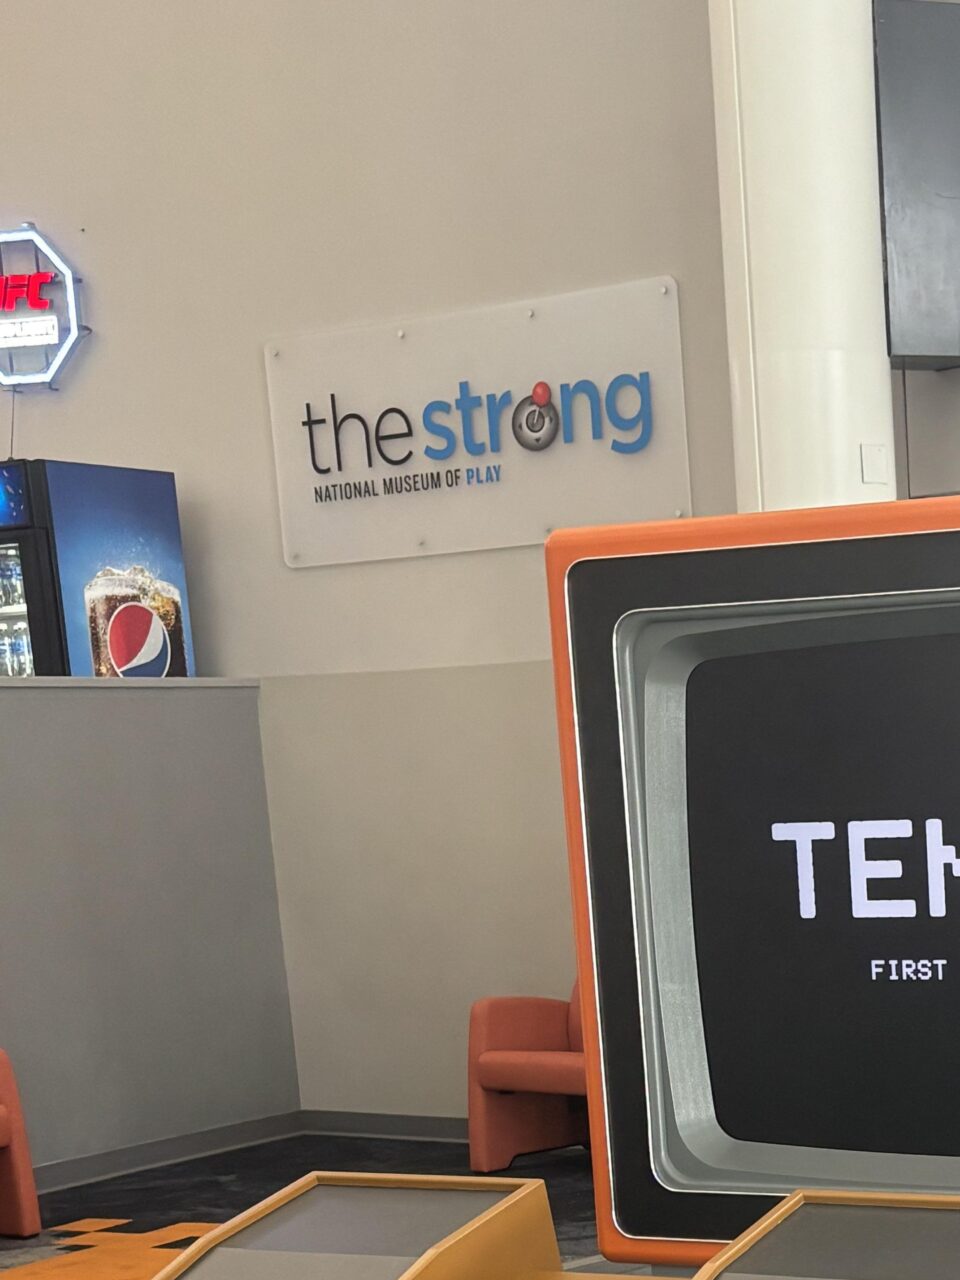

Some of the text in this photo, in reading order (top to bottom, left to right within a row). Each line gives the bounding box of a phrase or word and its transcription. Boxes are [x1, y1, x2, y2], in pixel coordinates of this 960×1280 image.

[0, 272, 55, 312] FC
[302, 371, 653, 474] the strong
[314, 465, 501, 503] NATIONAL MUSEUM OF PLAY
[871, 960, 947, 981] FIRST
